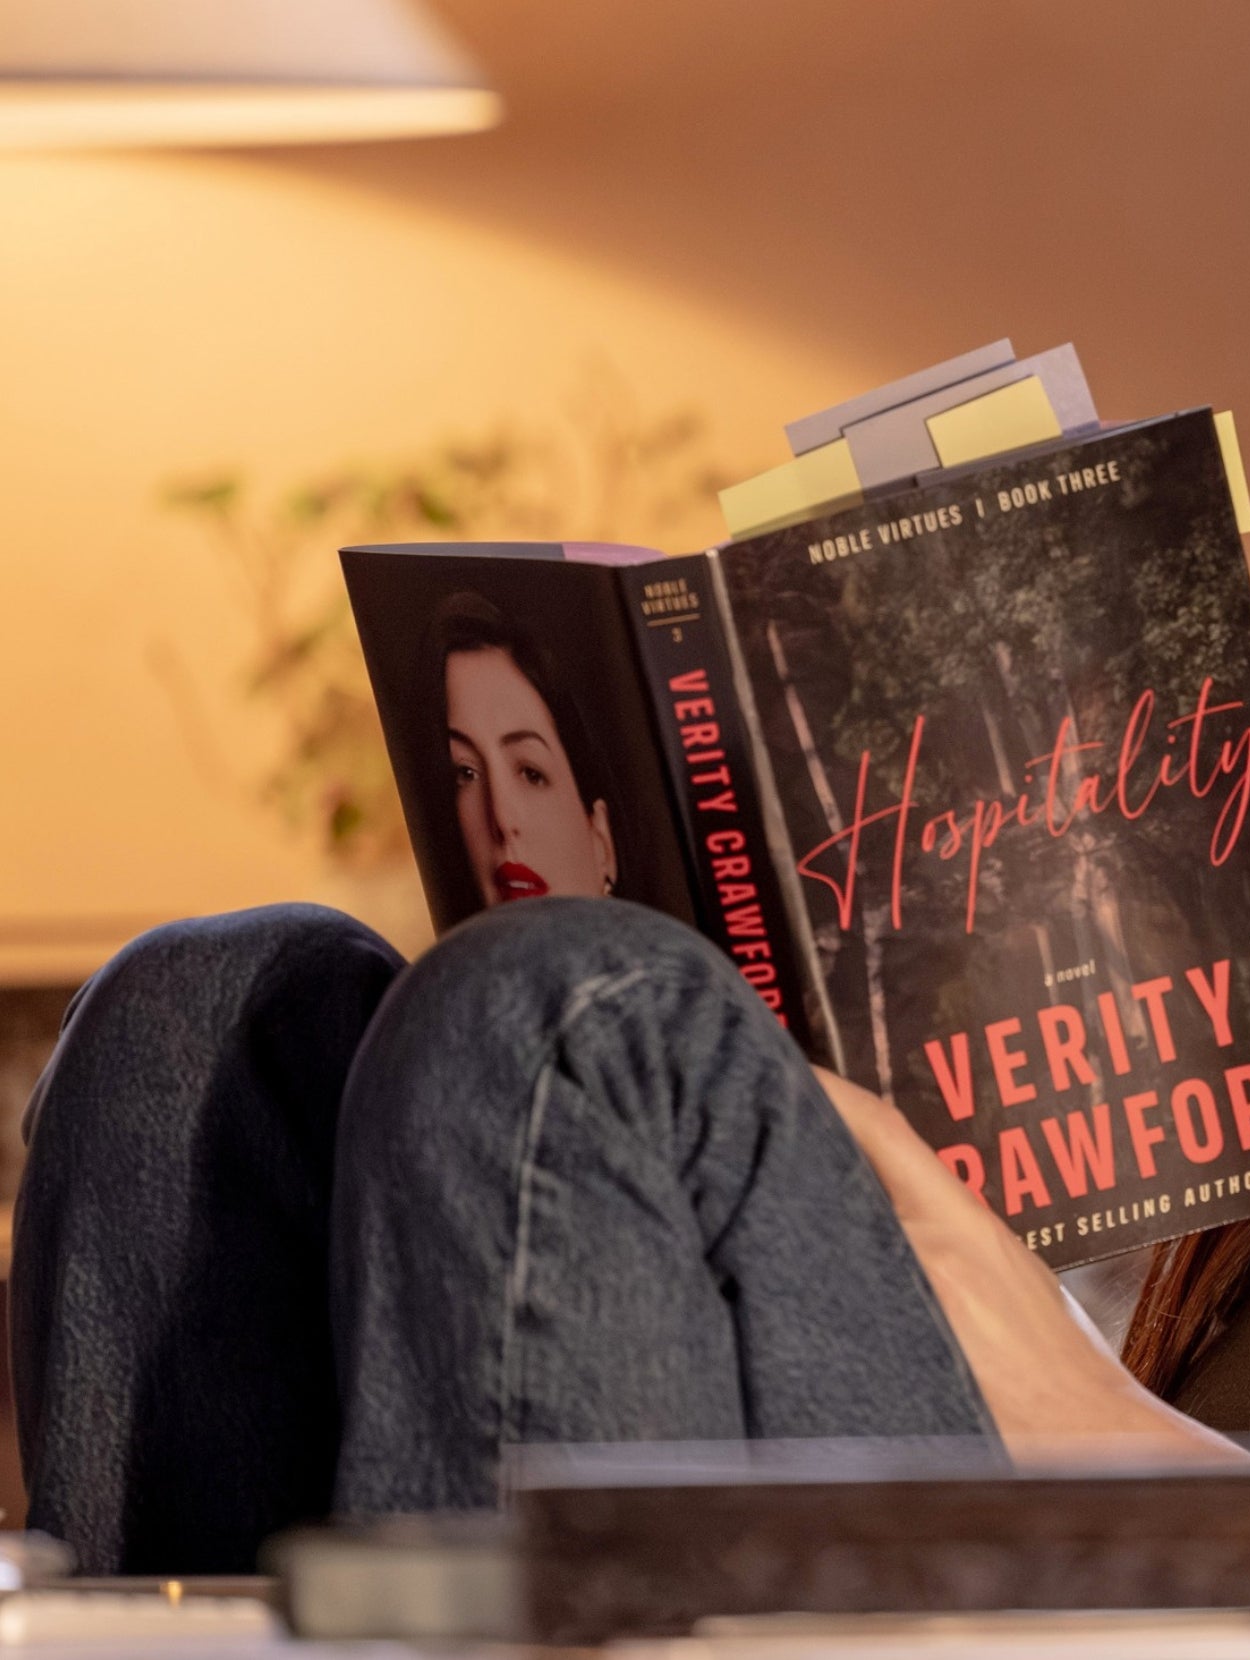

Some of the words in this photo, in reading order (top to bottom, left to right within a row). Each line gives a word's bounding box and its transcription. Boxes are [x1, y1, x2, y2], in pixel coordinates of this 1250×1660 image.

[807, 527, 873, 565] NOBLE
[877, 504, 963, 545] VIRTUES
[997, 479, 1053, 513] BOOK
[1056, 459, 1122, 496] THREE
[668, 668, 740, 814] VERITY
[706, 828, 789, 1029] CRAWFO
[1044, 973, 1054, 987] a
[1056, 958, 1096, 984] novel
[923, 958, 1235, 1123] VERITY
[1016, 1222, 1066, 1250] EST
[1076, 1193, 1172, 1237] SELLING
